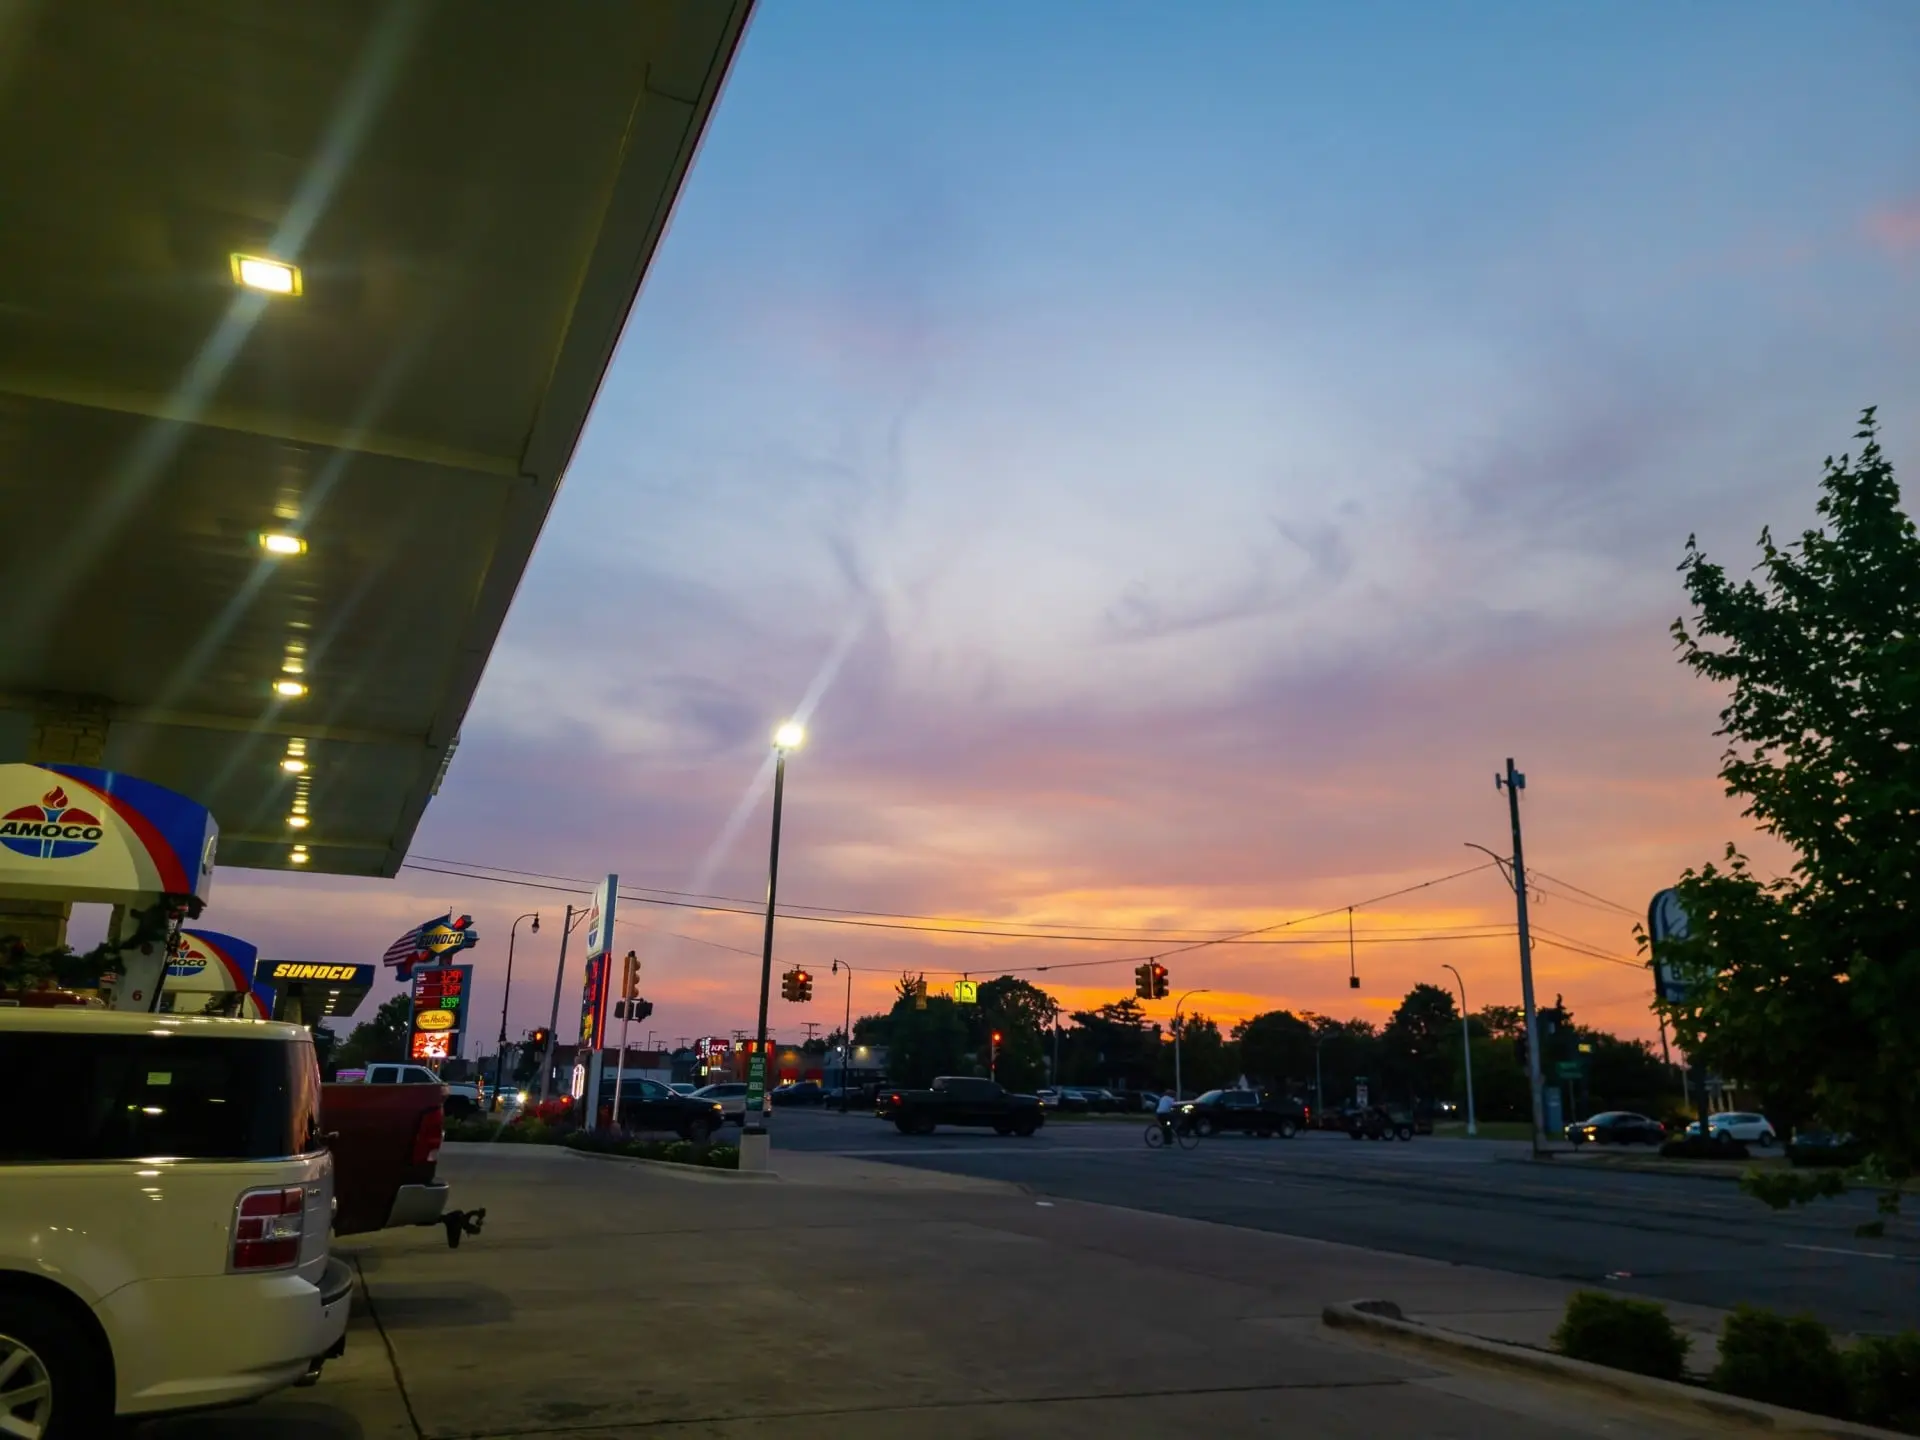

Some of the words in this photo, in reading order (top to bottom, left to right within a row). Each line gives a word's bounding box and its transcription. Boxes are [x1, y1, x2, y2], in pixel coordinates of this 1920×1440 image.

[0, 822, 103, 840] AMOCO
[168, 958, 207, 967] MOCO
[273, 963, 357, 980] SUNOCO
[132, 990, 143, 1001] 6
[711, 1044, 728, 1052] KFC
